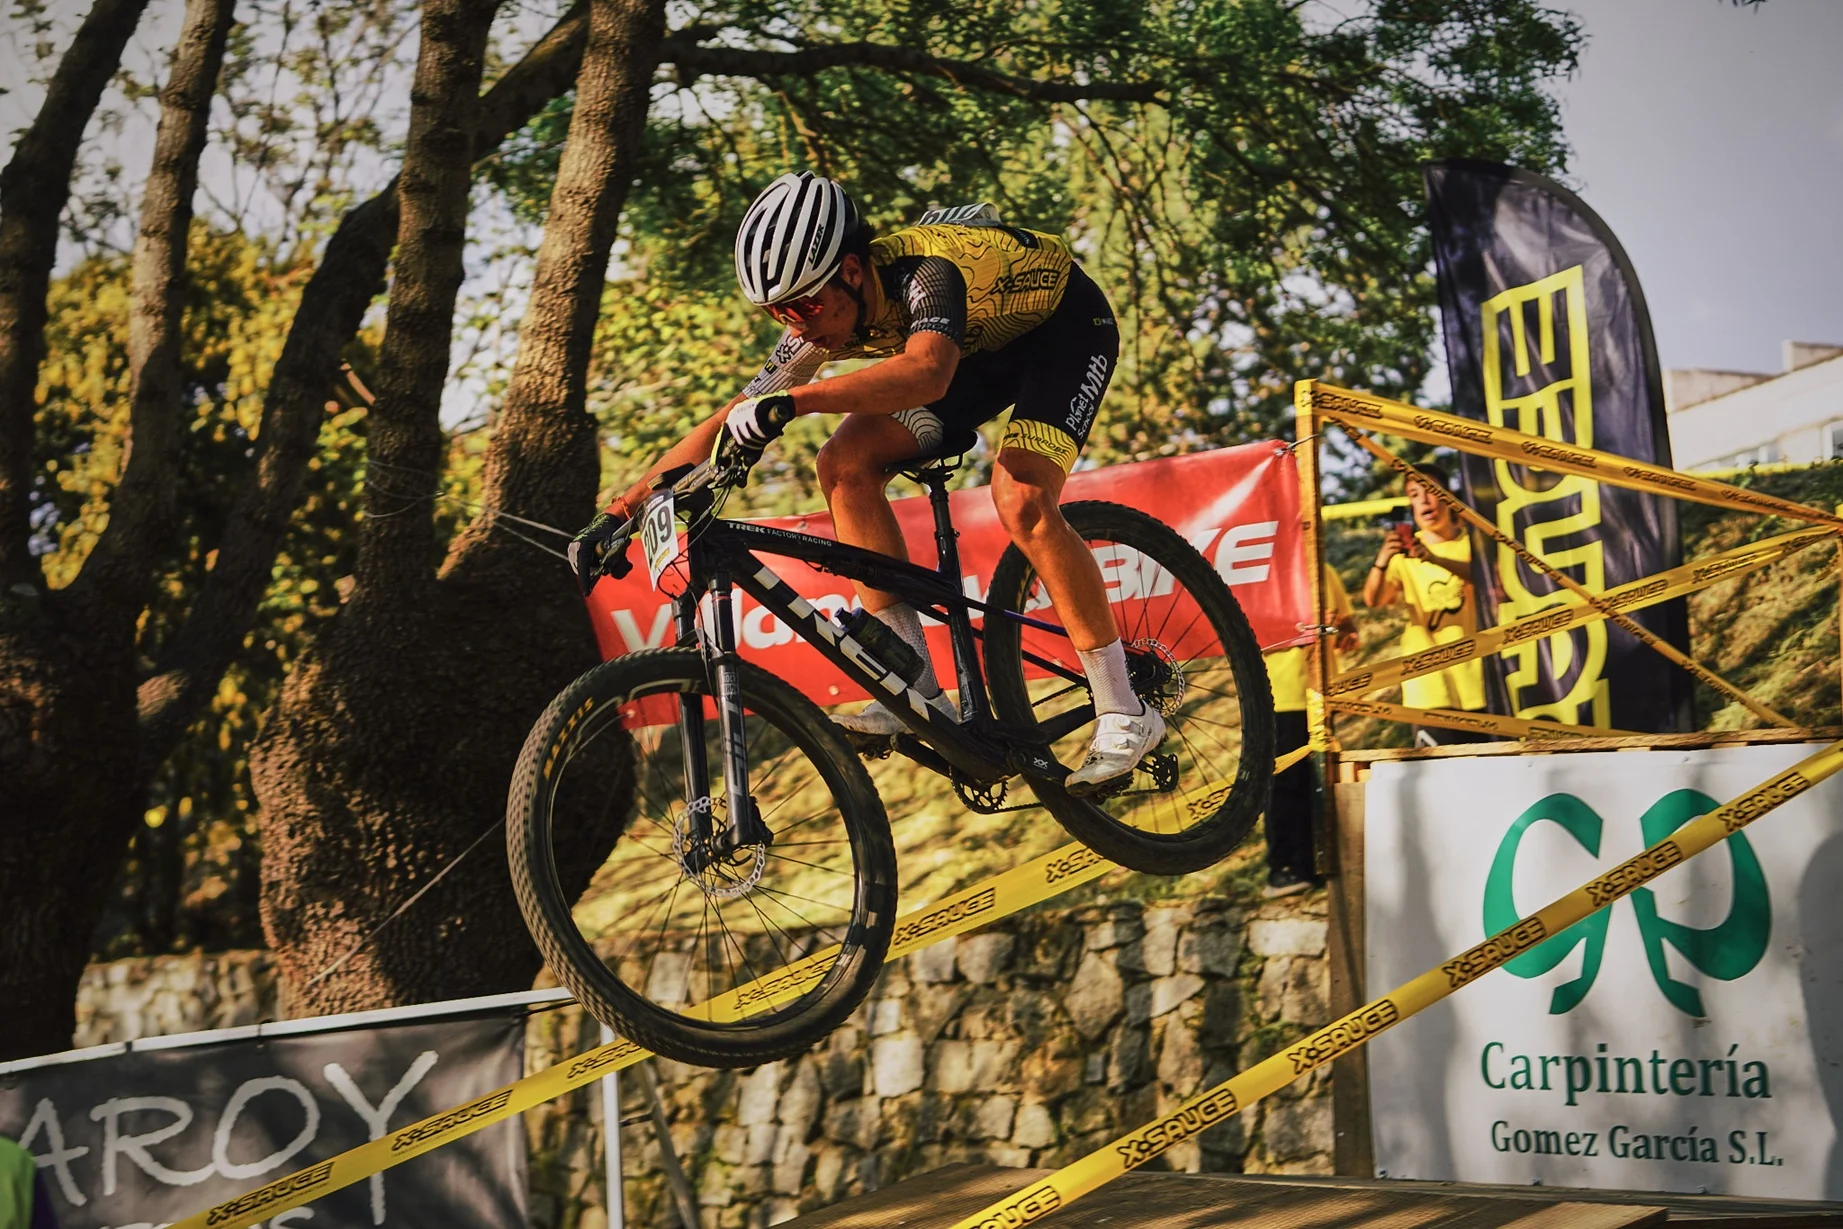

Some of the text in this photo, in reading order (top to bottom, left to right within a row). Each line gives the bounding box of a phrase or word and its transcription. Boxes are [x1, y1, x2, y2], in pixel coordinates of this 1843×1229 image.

[807, 223, 825, 264] LAZER
[990, 268, 1061, 295] X-SAUCE
[726, 522, 832, 547] TREK FACTORY RACING
[1717, 771, 1812, 833] X-SAUCE
[1585, 839, 1684, 908] X-SAUCE
[893, 886, 997, 946] X-SAUCE
[1442, 916, 1547, 989] X-SAUCE
[1287, 999, 1399, 1075] X-SAUCE
[1480, 1041, 1772, 1106] Carpintería
[391, 1089, 515, 1151] X-SAUCE
[1117, 1088, 1238, 1169] X-SAUCE
[1491, 1120, 1785, 1167] Gomez García S.L.
[206, 1161, 335, 1226] X-SAUCE
